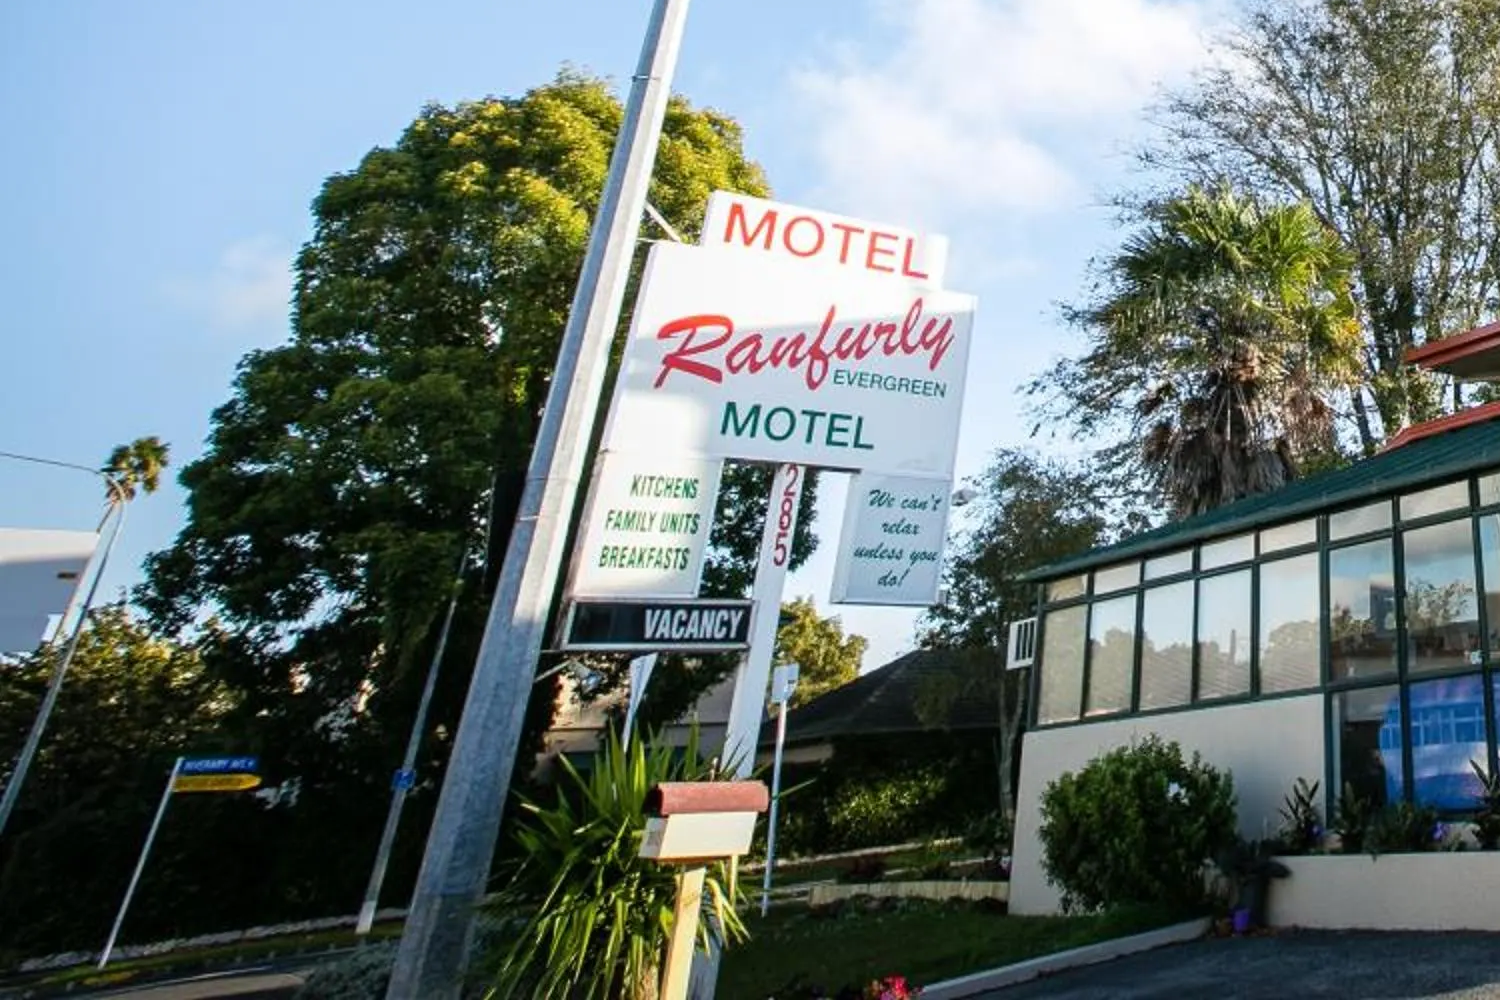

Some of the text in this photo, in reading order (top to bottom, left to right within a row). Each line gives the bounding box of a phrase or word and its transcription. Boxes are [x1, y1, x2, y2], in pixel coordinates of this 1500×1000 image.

[723, 202, 929, 280] MOTEL
[653, 297, 956, 390] Ranfurly
[833, 369, 947, 398] EVERGREEN
[720, 401, 874, 450] MOTEL
[630, 475, 699, 499] KITCHENS
[869, 489, 941, 511] We can't
[605, 509, 700, 535] FAMILY UNITS
[882, 518, 920, 535] relax
[598, 545, 690, 570] BREAKFASTS
[854, 542, 938, 566] unless you
[643, 609, 745, 640] VACANCY
